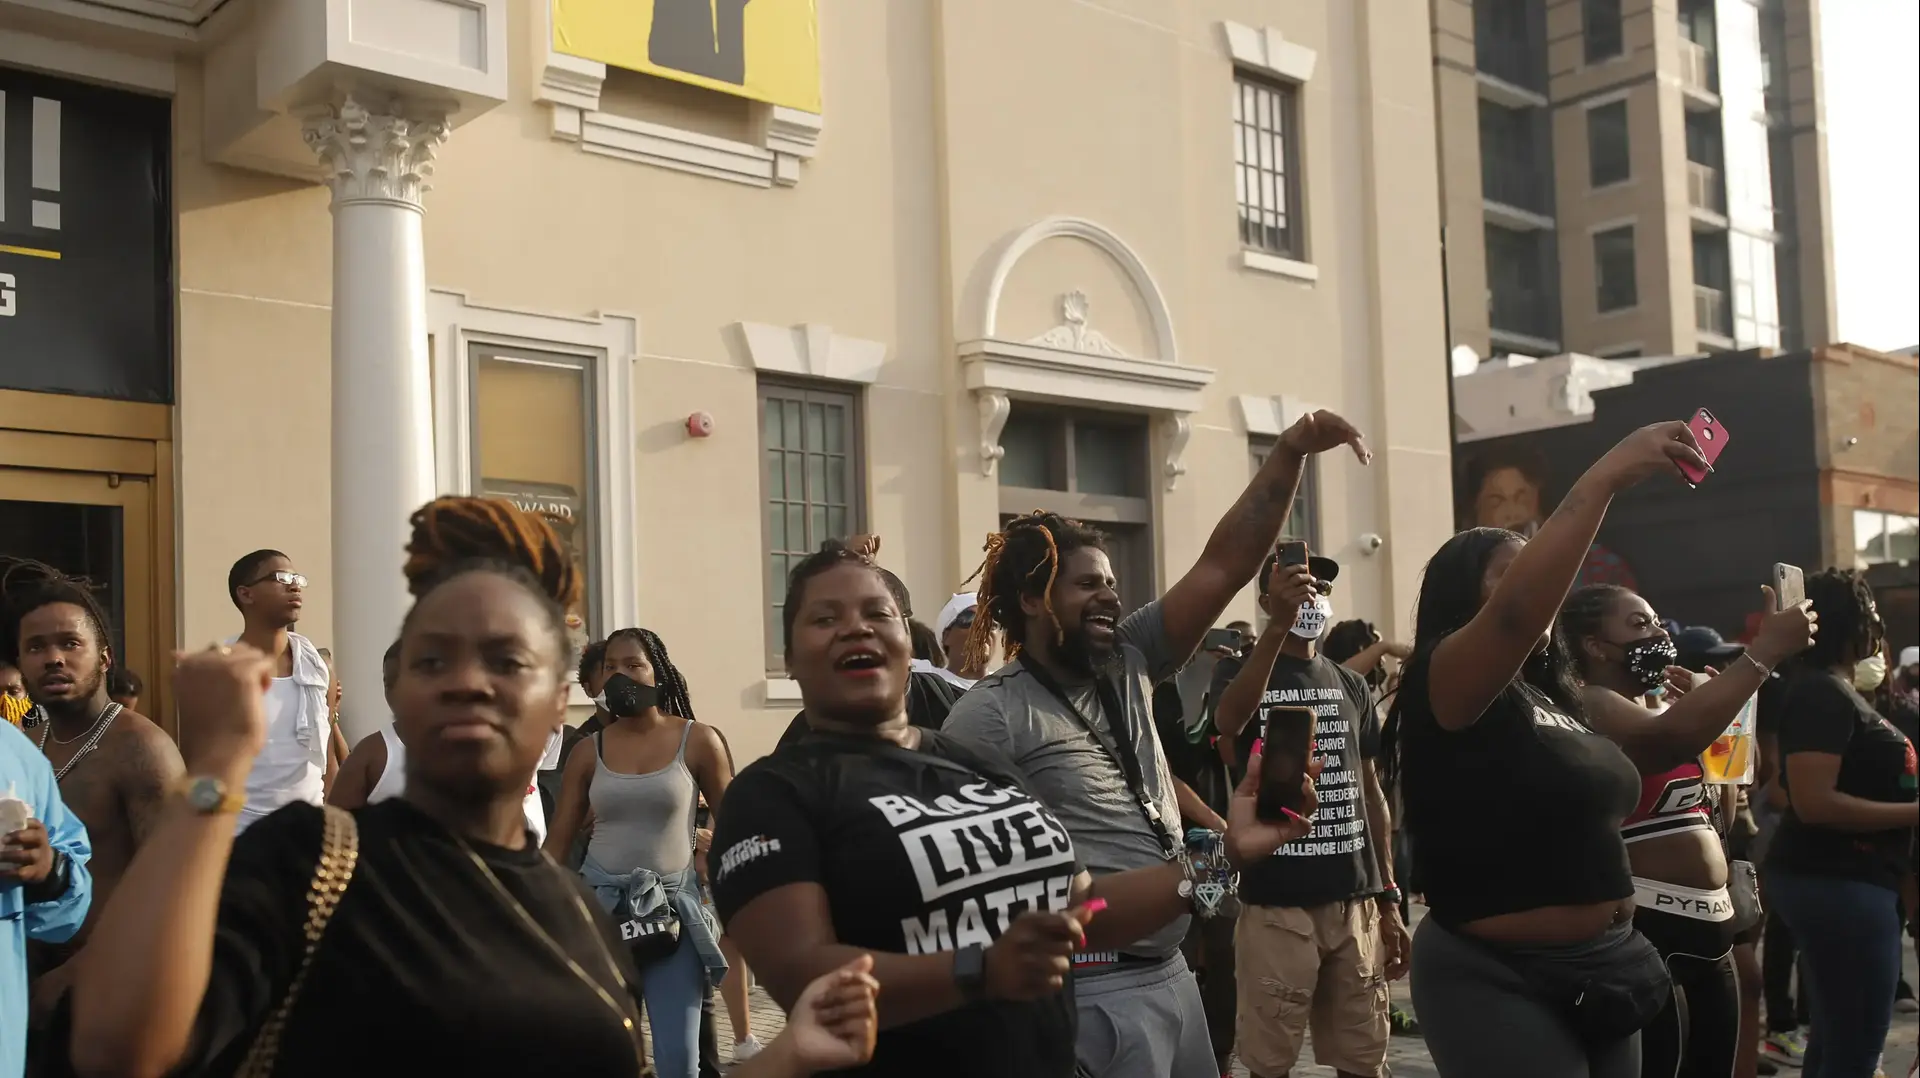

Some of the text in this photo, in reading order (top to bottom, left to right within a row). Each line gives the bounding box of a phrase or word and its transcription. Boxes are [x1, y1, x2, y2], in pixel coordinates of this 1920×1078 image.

[511, 500, 572, 518] WARD
[1261, 687, 1344, 703] REAM LIKE MARTIN
[1314, 720, 1350, 734] MALCOLM
[1318, 737, 1345, 751] GARVEY
[1320, 771, 1347, 785] MADAM
[1320, 806, 1336, 820] LIKE
[1317, 824, 1333, 838] LIKE
[919, 807, 1071, 887] LIVES
[1273, 841, 1336, 856] HALLENGE
[1337, 839, 1353, 854] LIKE
[901, 874, 1074, 956] MATTE
